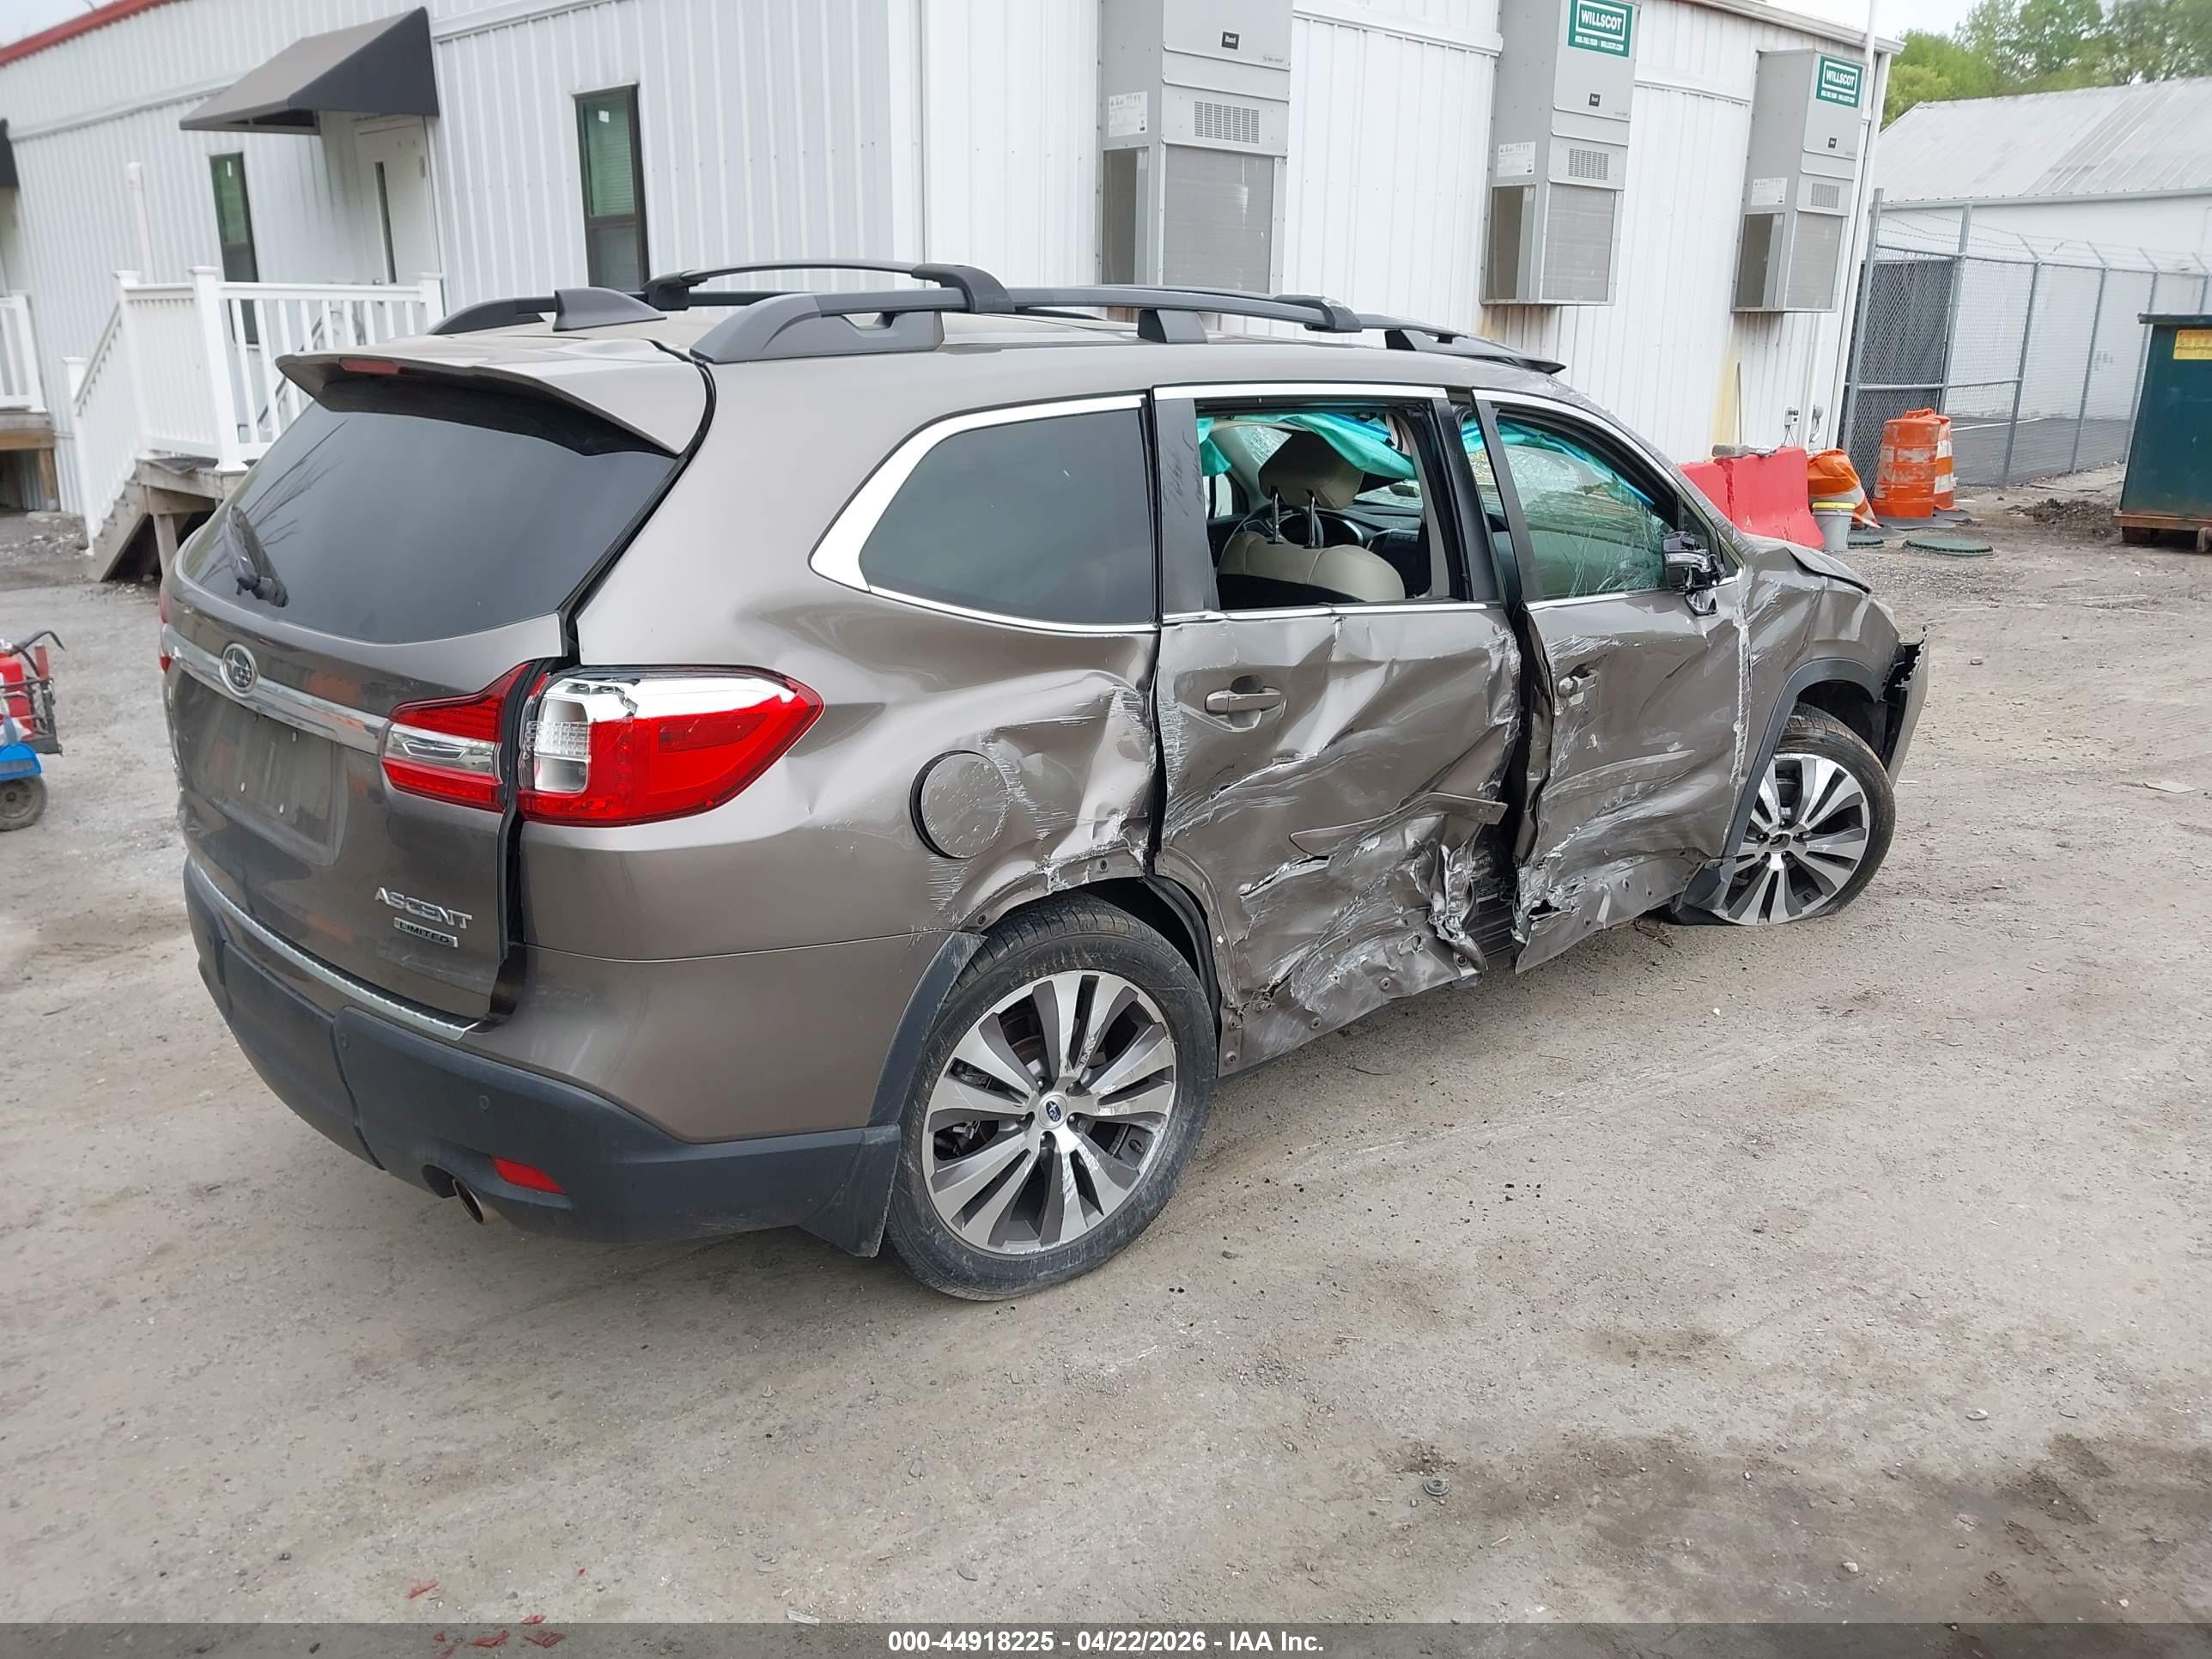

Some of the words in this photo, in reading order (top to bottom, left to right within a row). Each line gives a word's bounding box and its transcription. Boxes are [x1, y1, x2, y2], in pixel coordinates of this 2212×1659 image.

[1581, 9, 1622, 31] WILLSCOT
[1826, 70, 1856, 88] WILLSCOT
[375, 886, 472, 929] ASCENT
[399, 921, 449, 944] LIMITED
